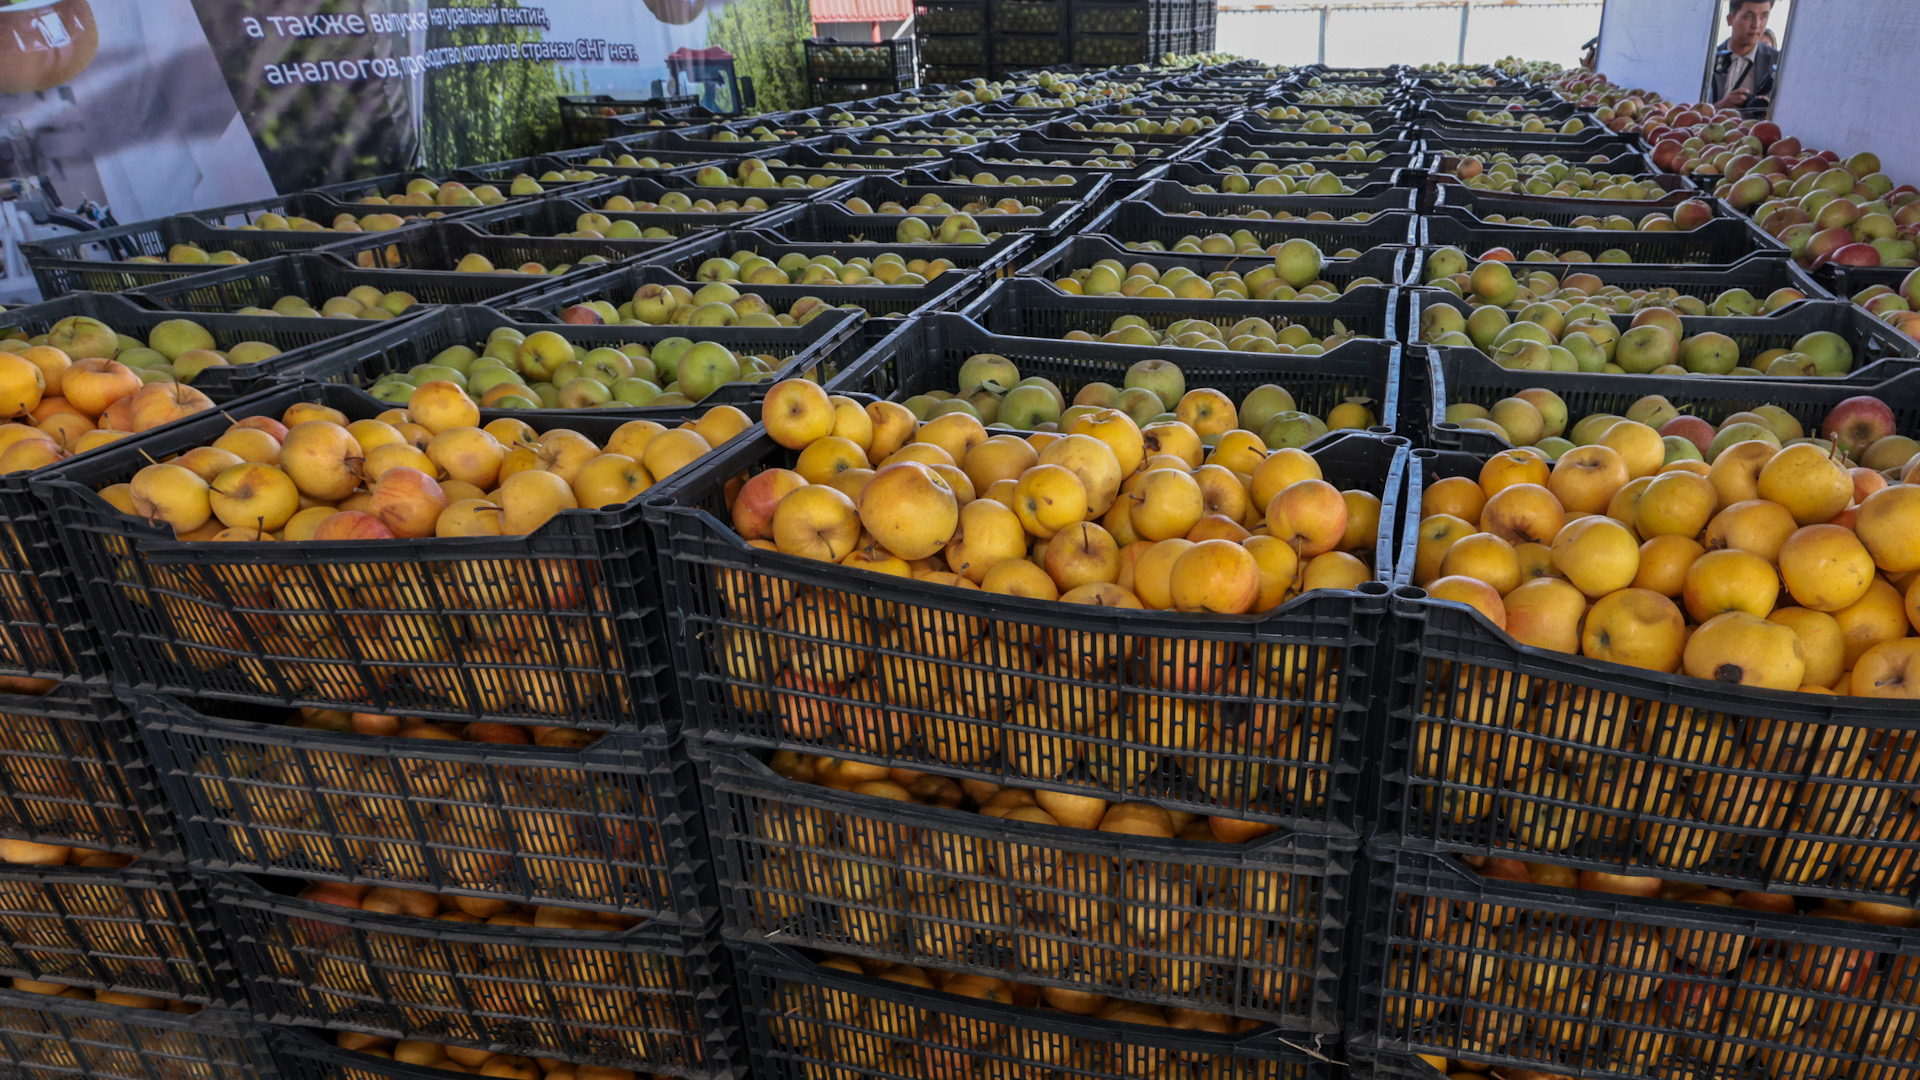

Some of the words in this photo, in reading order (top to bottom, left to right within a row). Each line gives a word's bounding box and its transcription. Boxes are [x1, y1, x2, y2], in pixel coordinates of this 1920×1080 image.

[243, 16, 264, 38] а
[266, 14, 367, 37] также
[429, 4, 499, 30] натуральный
[501, 7, 550, 29] пектин,
[264, 57, 403, 85] аналогов,
[462, 43, 510, 65] которого
[511, 43, 520, 57] в
[521, 42, 575, 63] странах
[575, 38, 606, 61] СНГ
[608, 43, 639, 61] нет.
